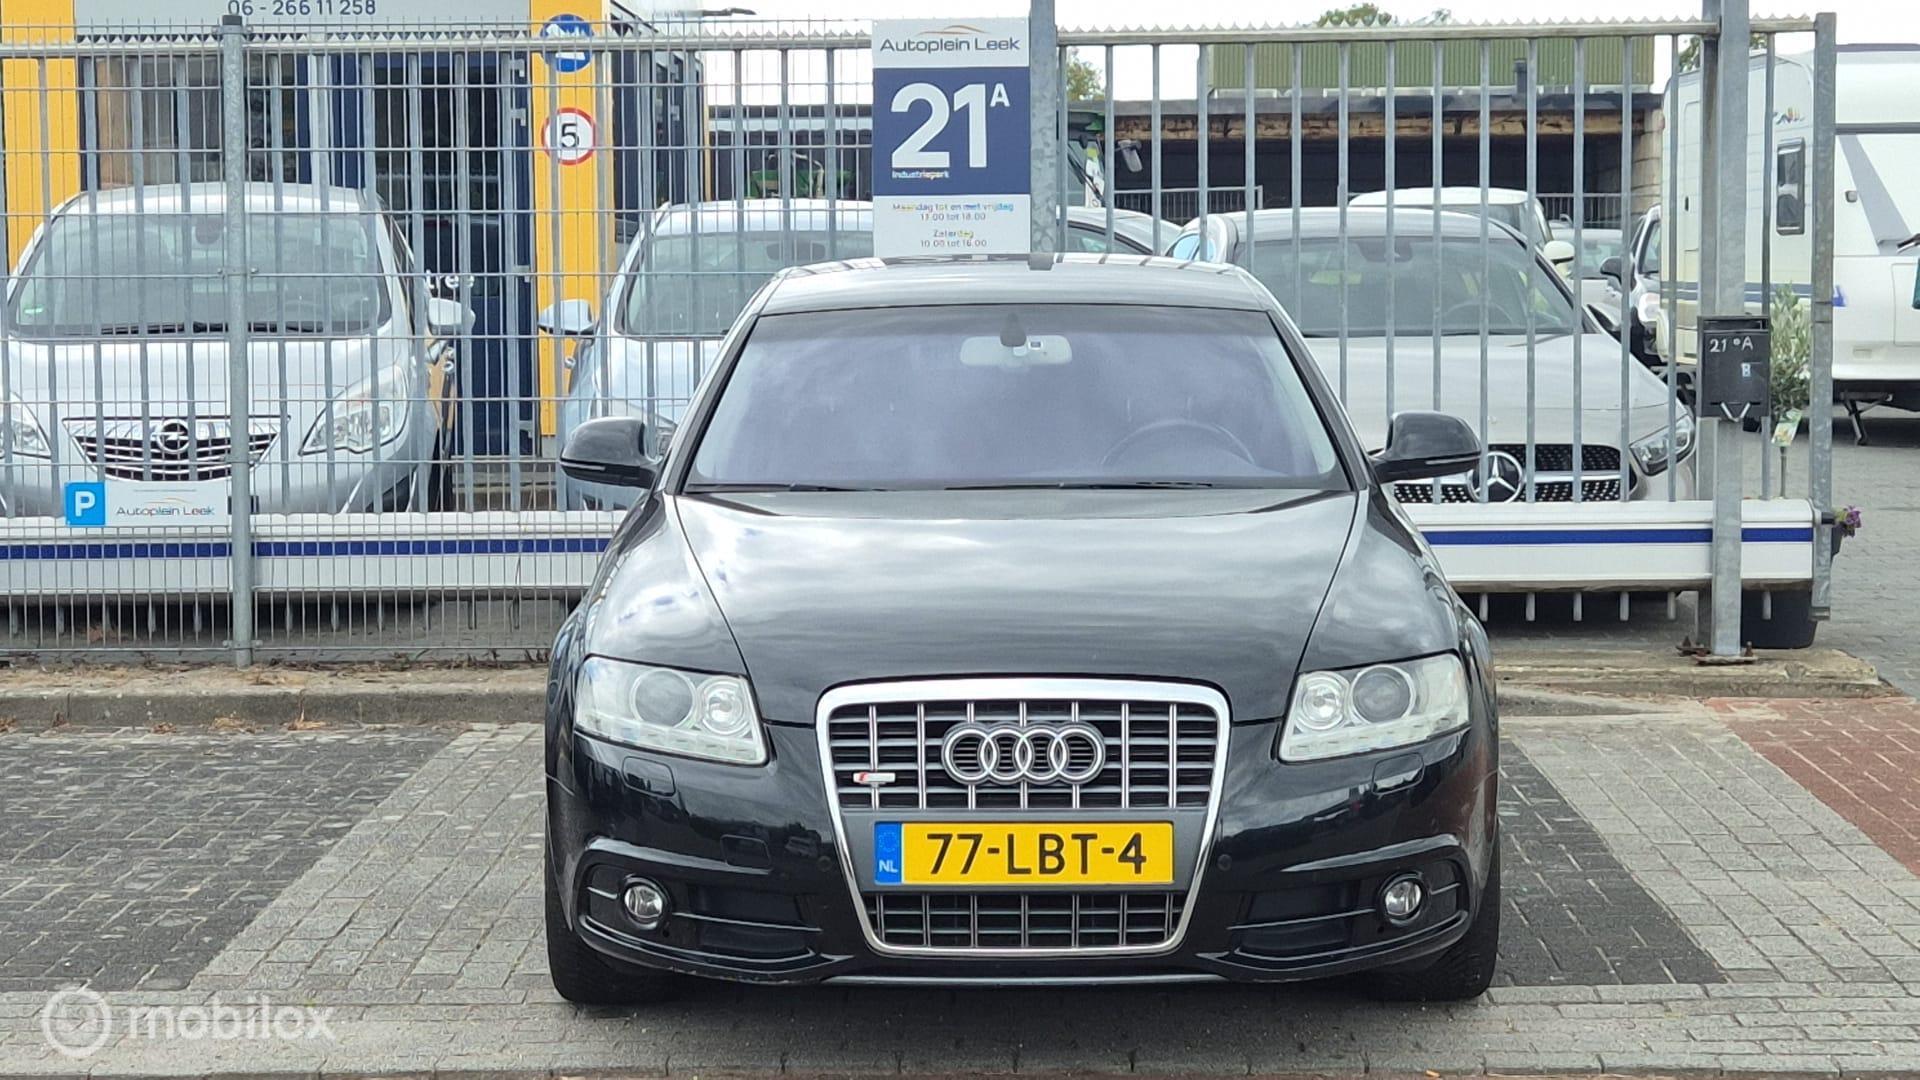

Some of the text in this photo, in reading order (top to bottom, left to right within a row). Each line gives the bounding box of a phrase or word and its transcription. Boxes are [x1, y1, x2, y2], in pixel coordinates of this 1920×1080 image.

[228, 0, 253, 15] 06
[273, 0, 310, 15] 266
[316, 0, 332, 15] 11
[340, 0, 376, 15] 258
[880, 37, 1021, 53] Autoplein Leek
[561, 123, 580, 147] 5
[947, 213, 960, 221] tot
[947, 239, 960, 247] tot
[1710, 338, 1727, 352] 21
[75, 491, 95, 517] P
[116, 505, 215, 517] Autoplein Leek
[926, 832, 1147, 875] 77-LBT-4
[878, 860, 898, 873] NL
